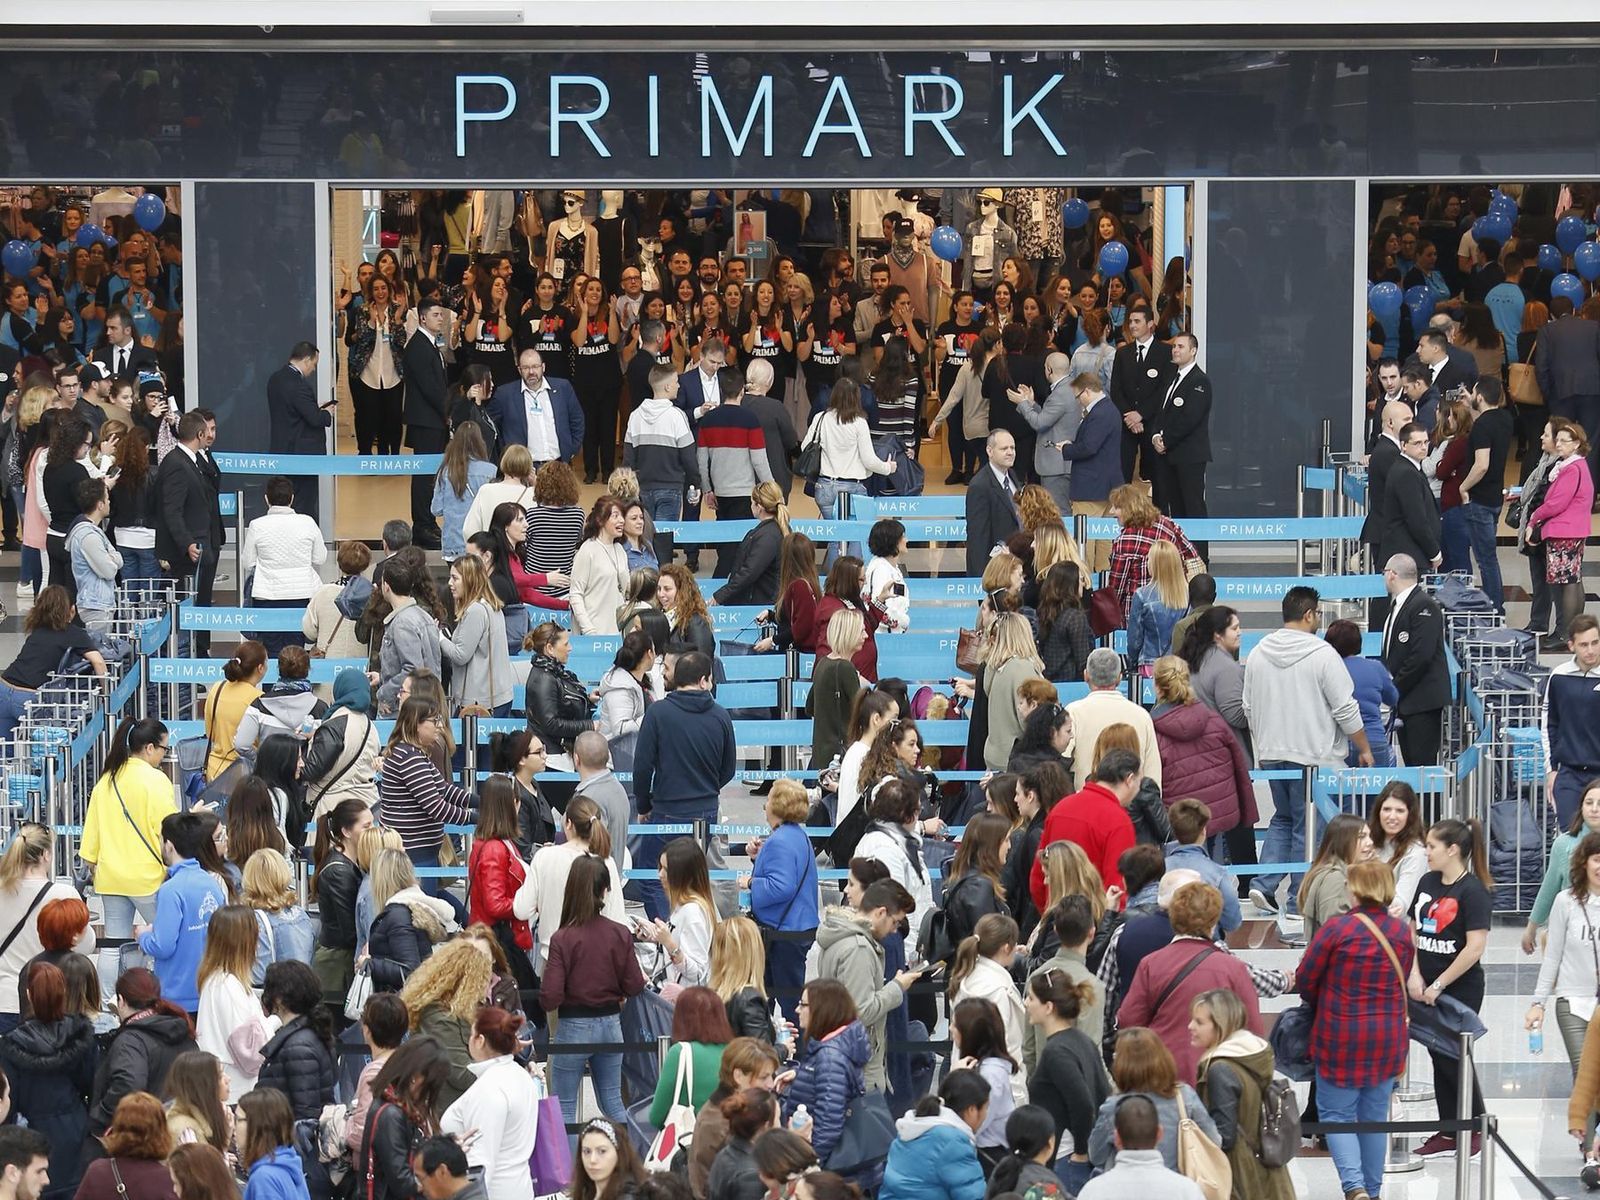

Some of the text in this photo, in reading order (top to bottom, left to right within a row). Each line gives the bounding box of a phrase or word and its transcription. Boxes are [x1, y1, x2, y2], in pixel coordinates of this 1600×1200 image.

[454, 74, 1066, 158] PRIMARK
[578, 343, 610, 356] PRIMARK
[216, 457, 277, 469] PRIMARK
[360, 460, 421, 470] PRIMARK
[1220, 525, 1284, 535] PRIMARK
[184, 613, 254, 625] PRIMARK
[714, 824, 769, 835] PRIMARK
